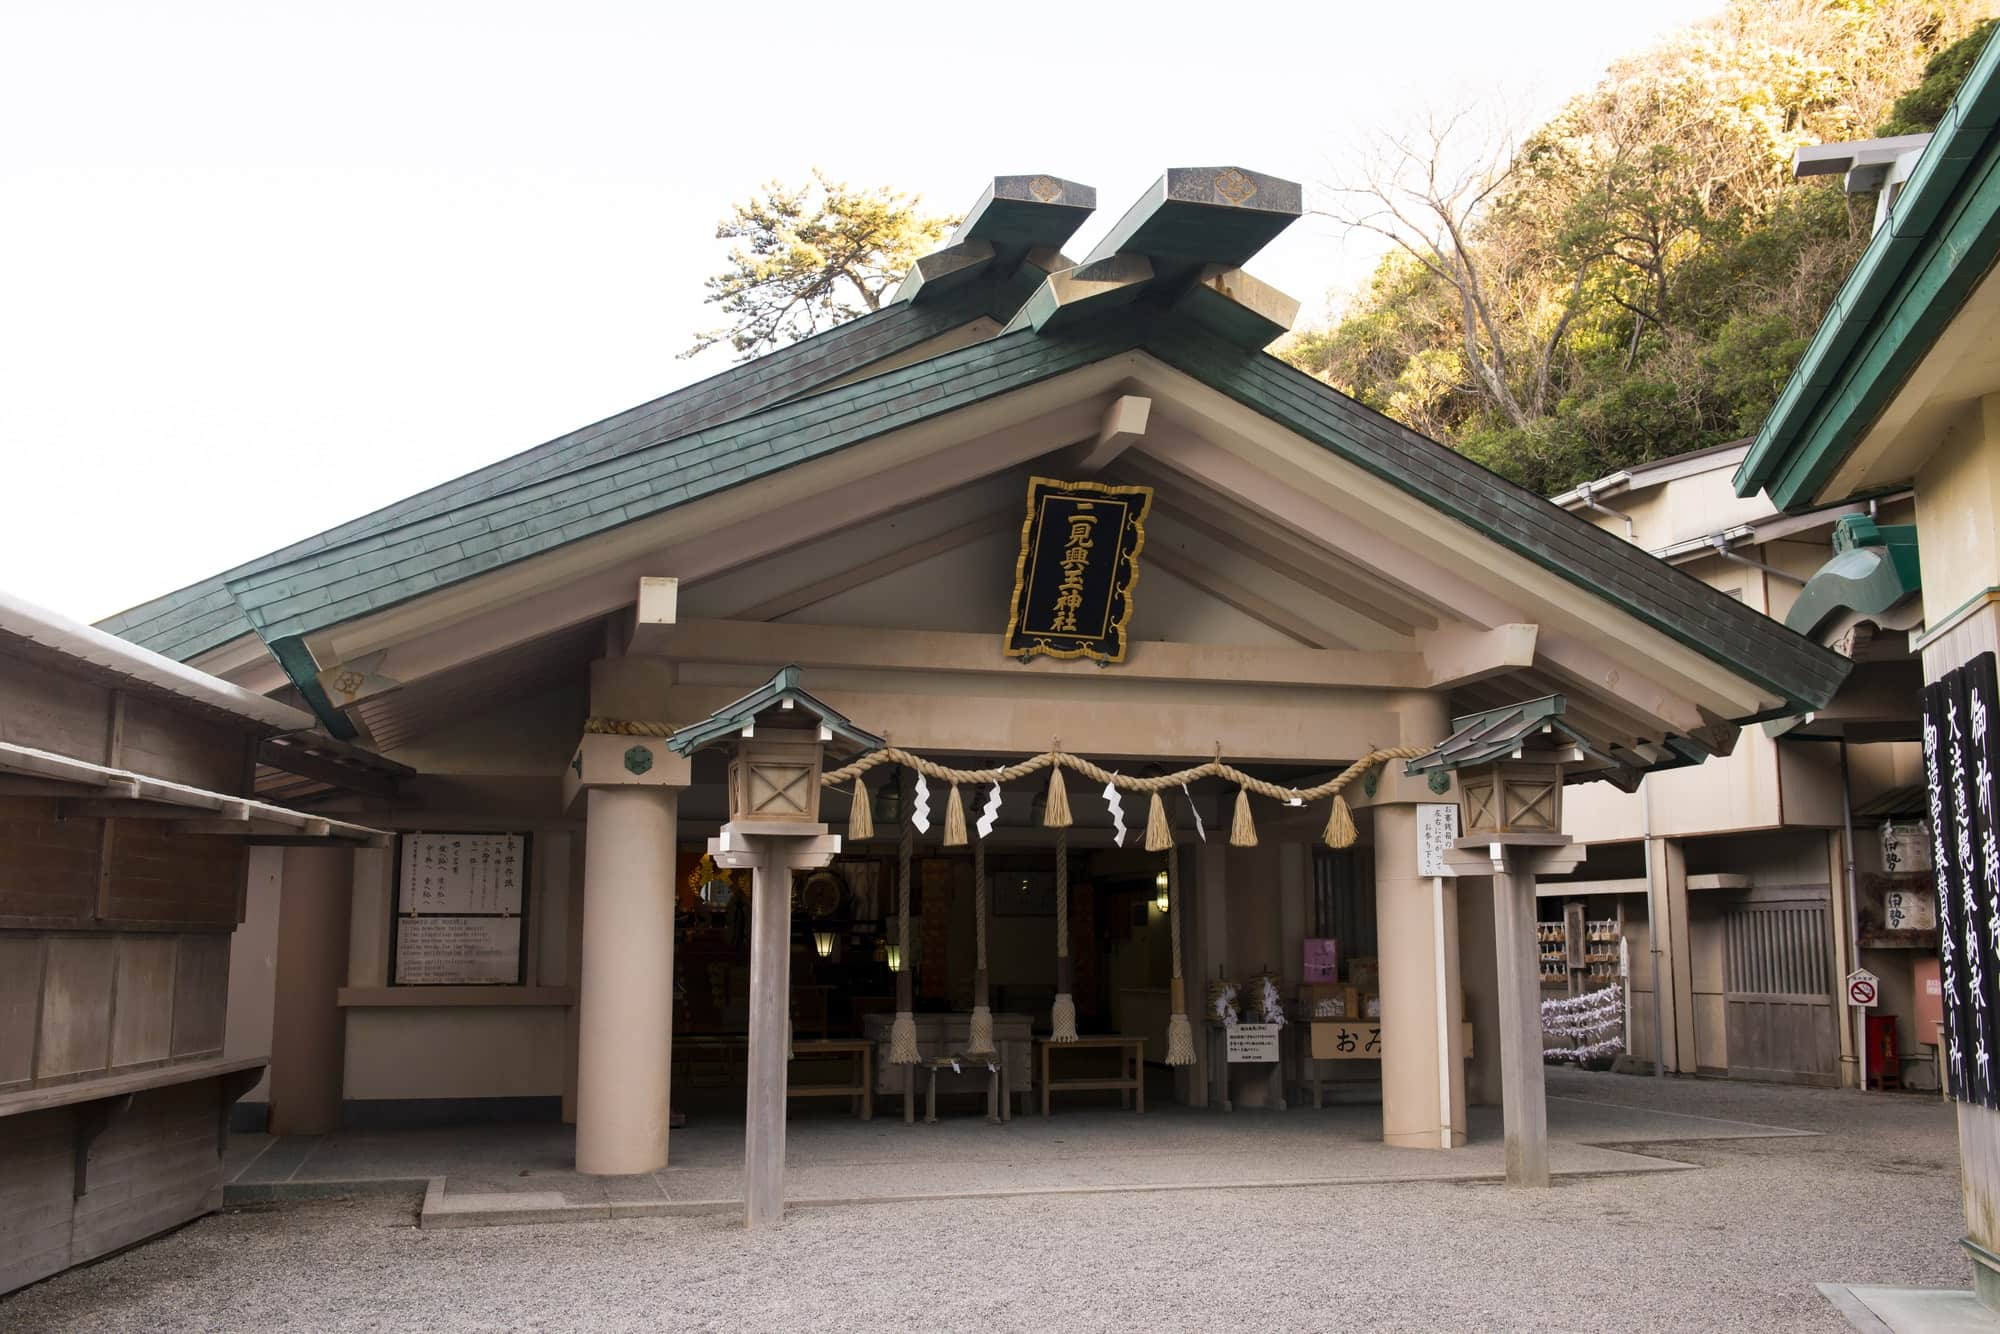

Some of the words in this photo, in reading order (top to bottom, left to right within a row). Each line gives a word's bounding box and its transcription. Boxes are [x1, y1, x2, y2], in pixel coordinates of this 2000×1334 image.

[1050, 502, 1099, 632] 二見興玉神社
[1971, 687, 2000, 955] 御祈祷承
[1424, 823, 1432, 874] お参り下さい
[1884, 837, 1901, 872] 伊勢
[1889, 893, 1906, 929] 伊勢
[1336, 1028, 1382, 1053] おみ
